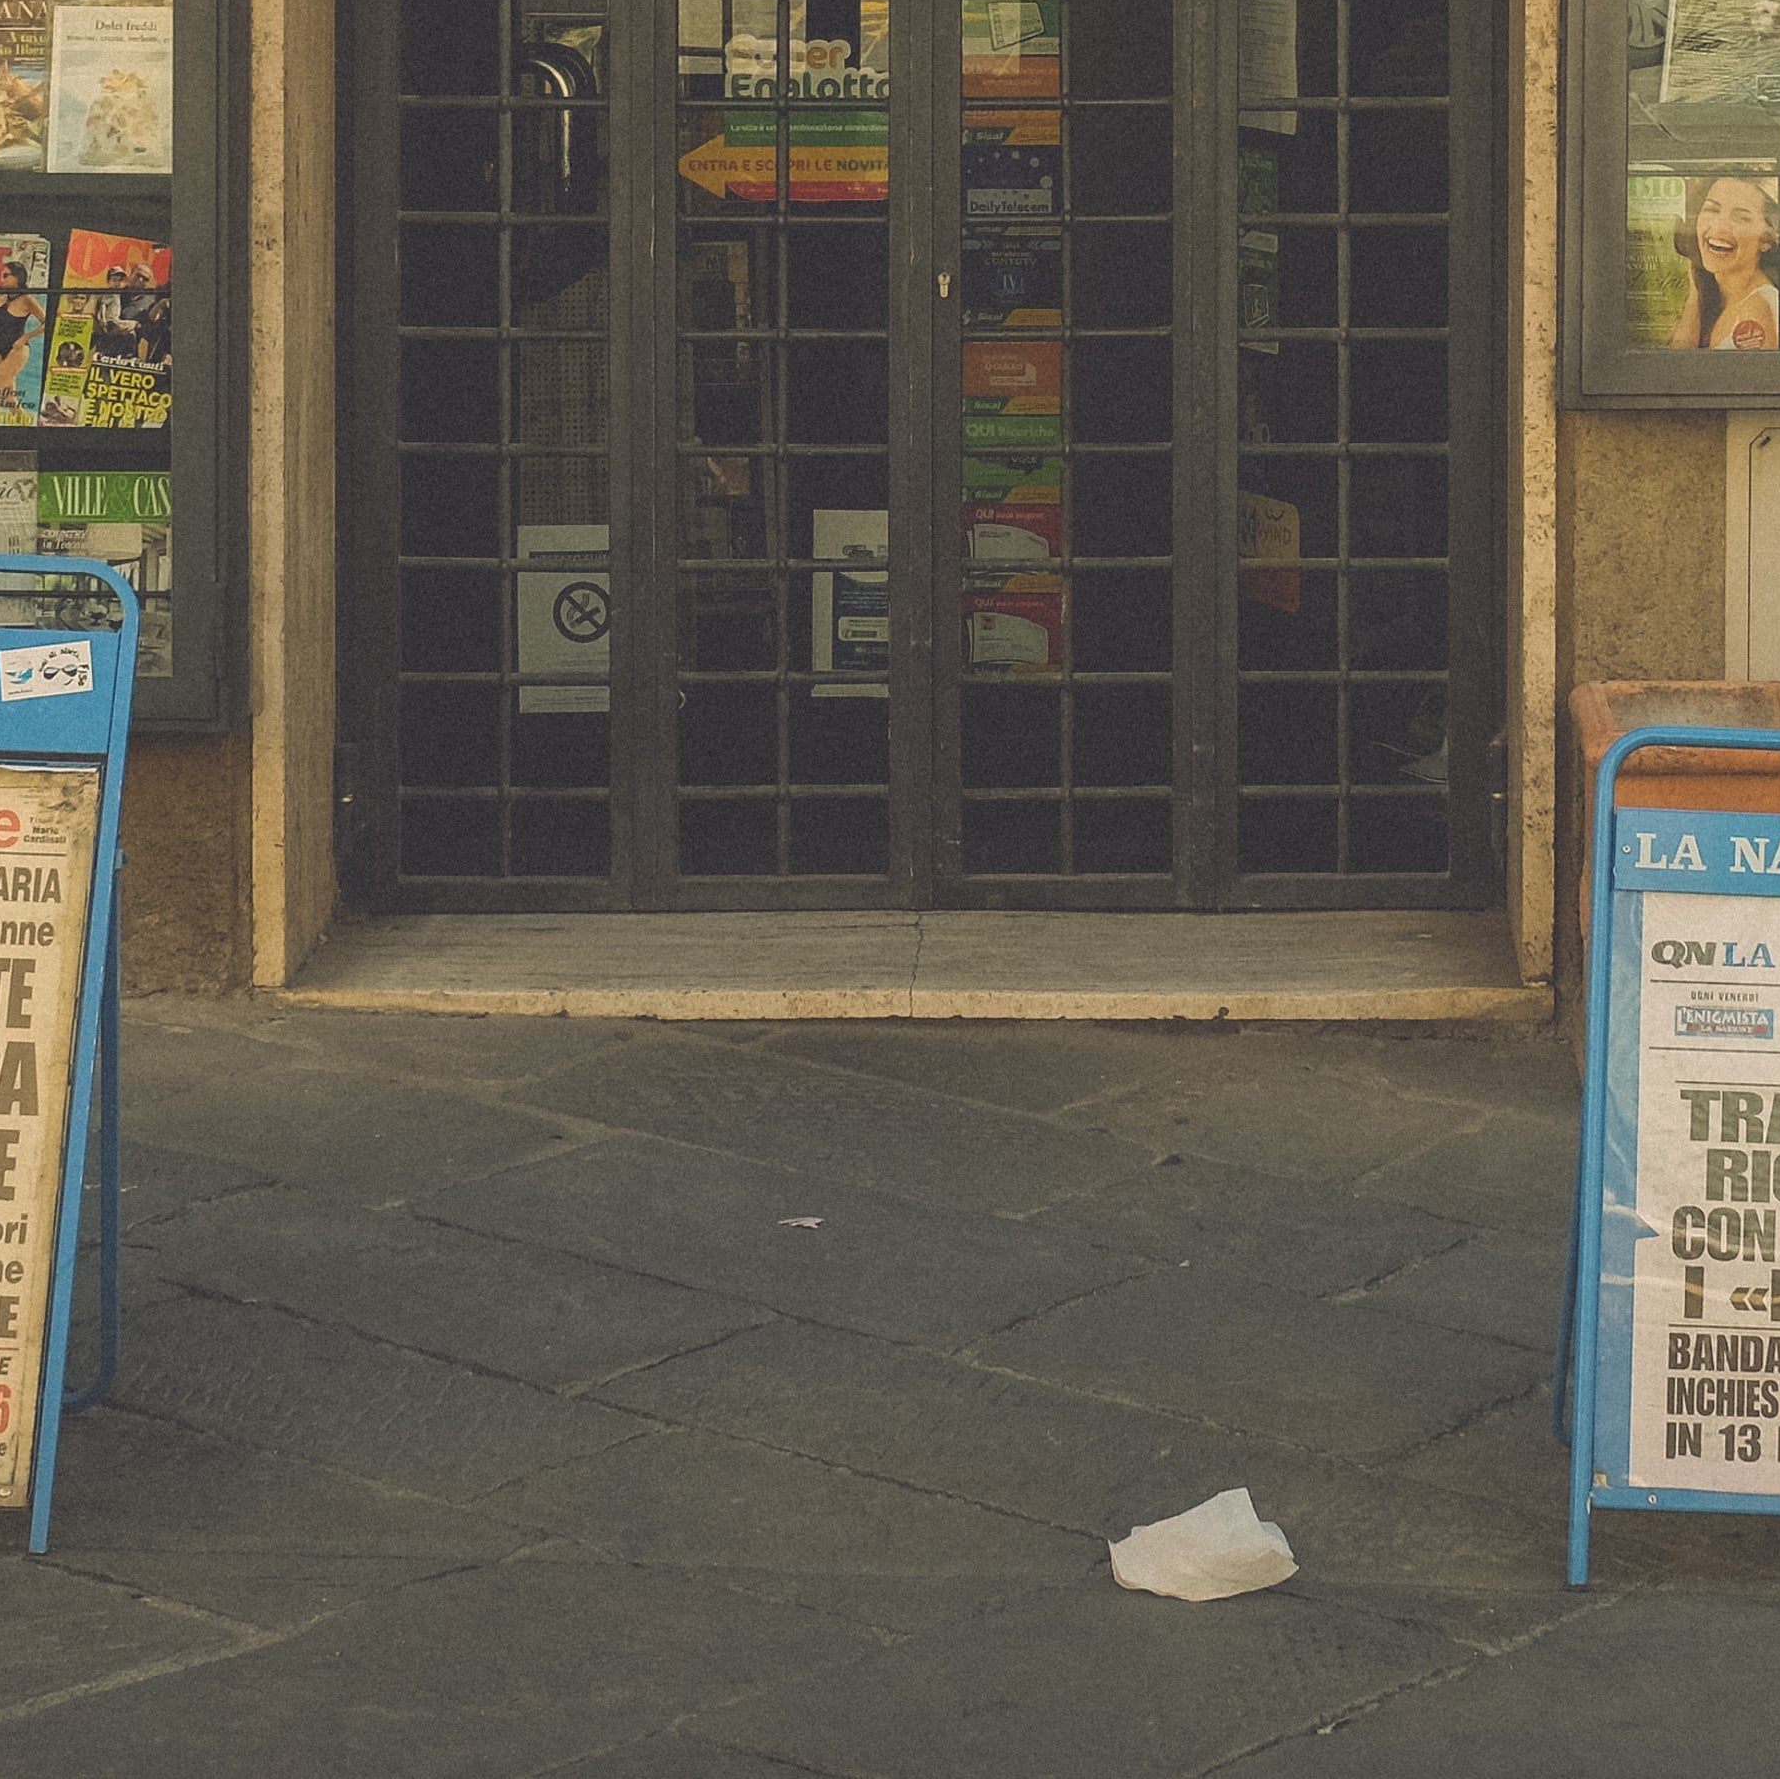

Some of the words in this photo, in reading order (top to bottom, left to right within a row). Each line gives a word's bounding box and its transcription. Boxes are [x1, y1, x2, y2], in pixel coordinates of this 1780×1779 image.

[688, 159, 738, 171] ENTRA
[742, 159, 750, 171] E
[815, 159, 832, 171] LE
[89, 366, 104, 383] IL
[109, 369, 155, 390] VERO
[52, 476, 107, 517] VILLE
[1635, 832, 1707, 871] LA
[1722, 942, 1776, 969] LA
[1671, 1205, 1777, 1263] CON
[1717, 1423, 1762, 1462] 13
